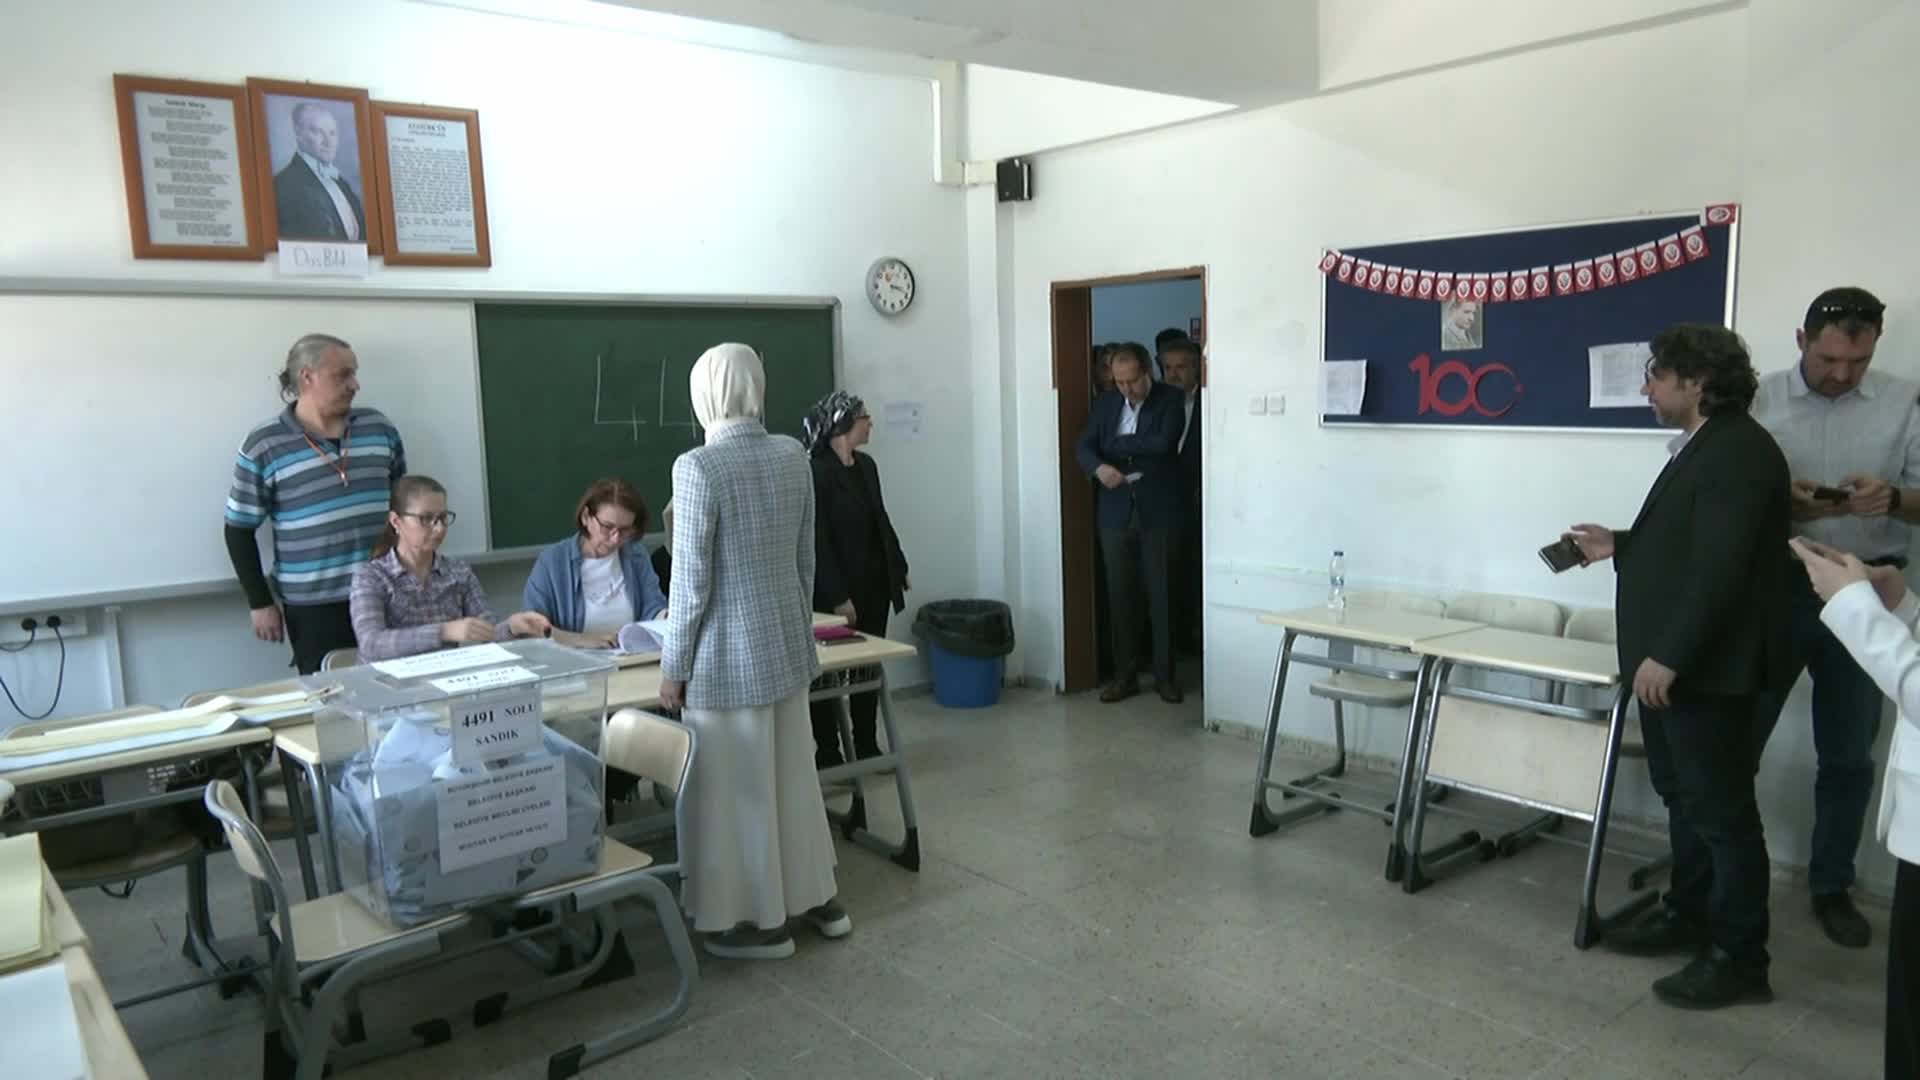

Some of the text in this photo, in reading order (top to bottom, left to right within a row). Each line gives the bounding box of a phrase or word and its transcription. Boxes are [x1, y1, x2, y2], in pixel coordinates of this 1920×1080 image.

[1408, 352, 1525, 417] 100
[462, 703, 536, 728] 4491 NOLU
[475, 729, 519, 745] SANDIK
